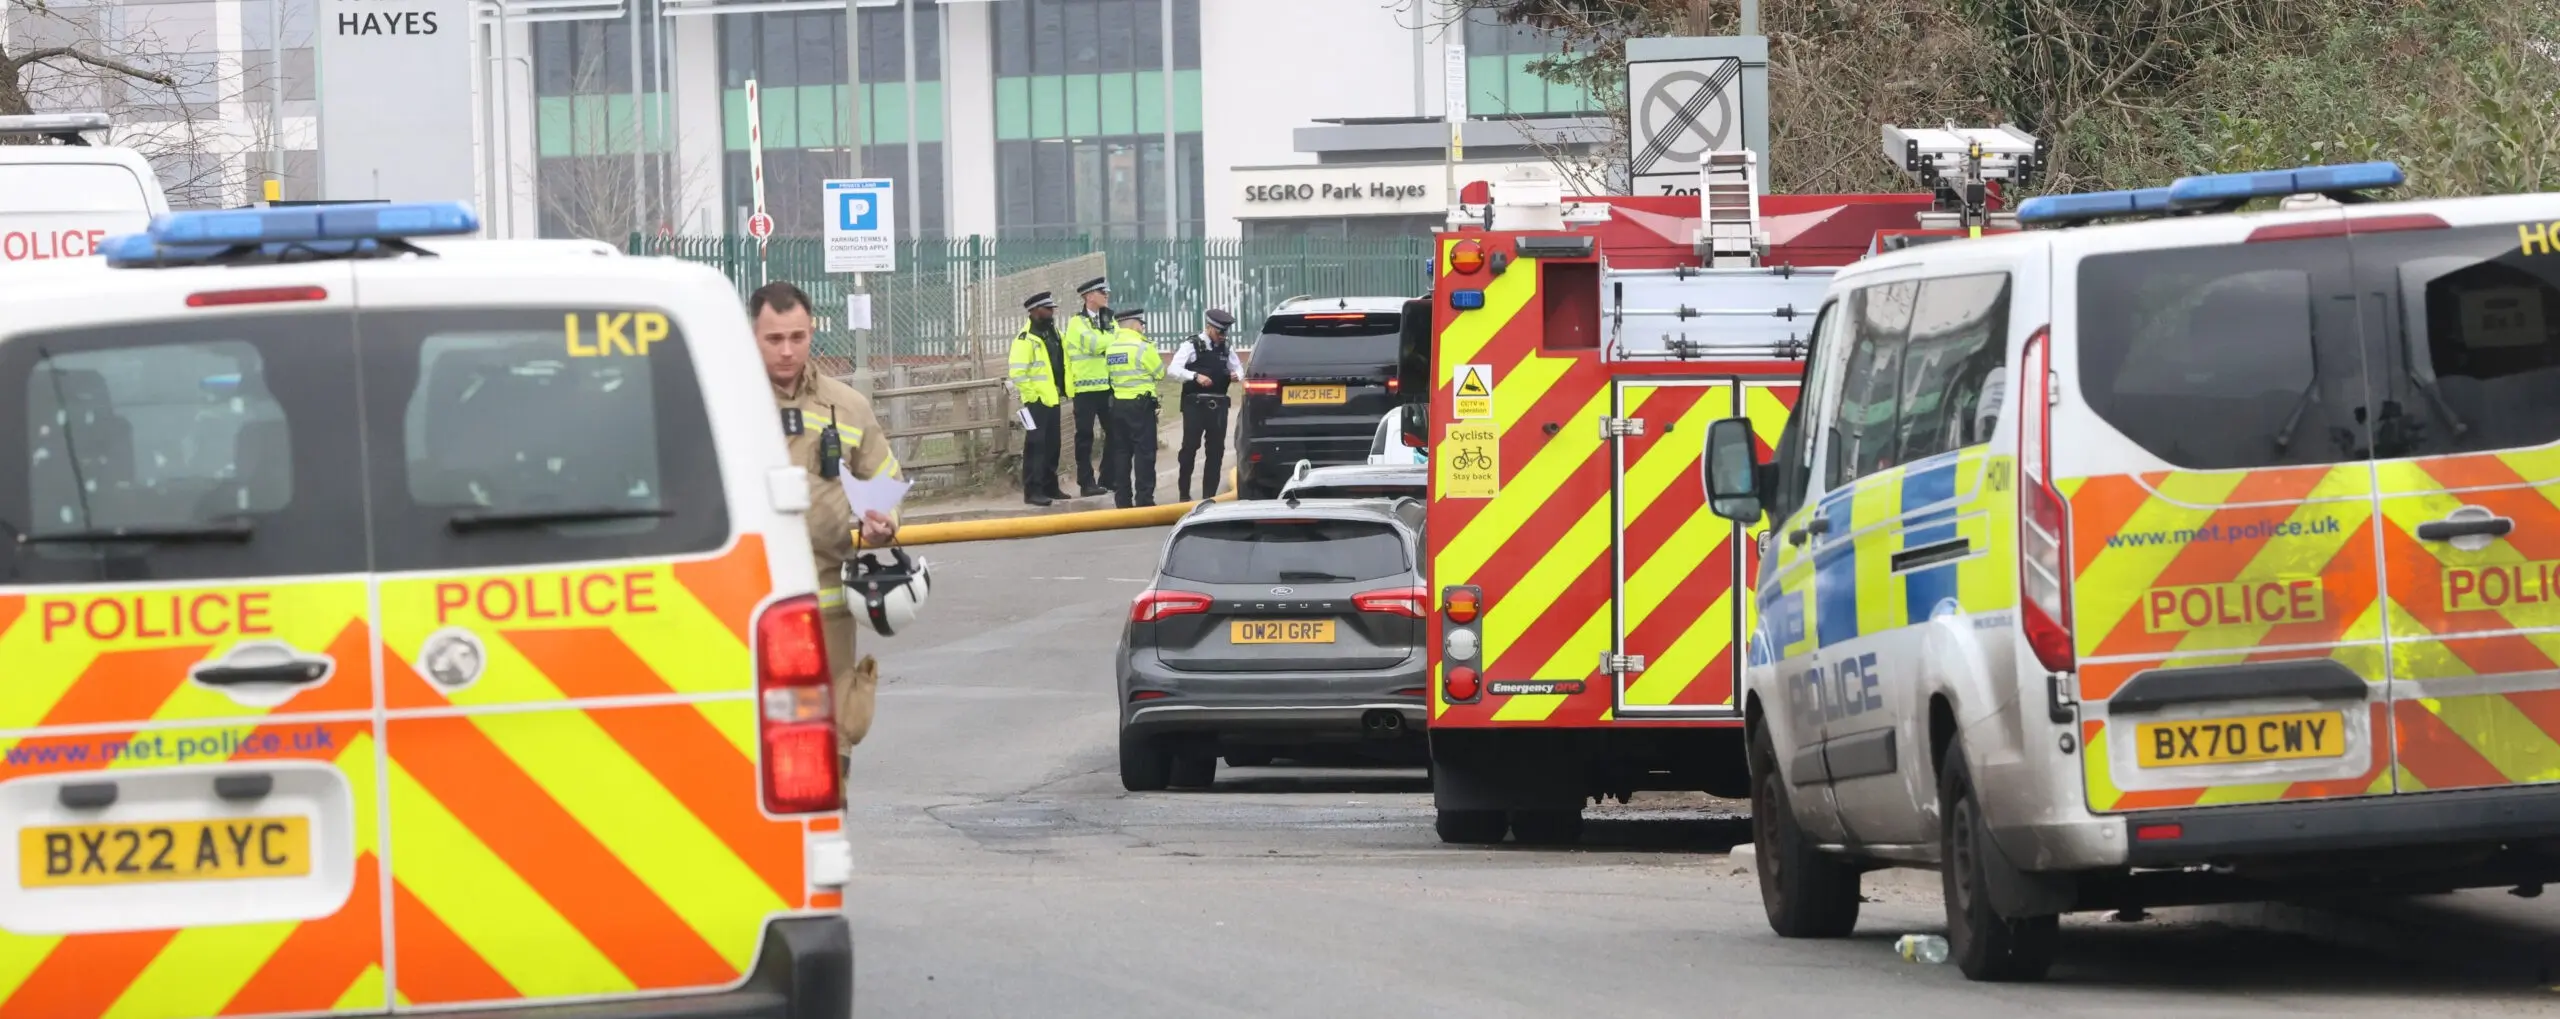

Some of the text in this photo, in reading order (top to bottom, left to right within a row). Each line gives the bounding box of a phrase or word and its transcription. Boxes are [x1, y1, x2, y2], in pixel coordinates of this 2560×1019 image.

[338, 11, 438, 36] HAYES
[1245, 181, 1426, 201] SEGRO Park Hayes
[848, 199, 870, 225] P
[830, 244, 868, 252] CONDITIONS
[564, 311, 669, 357] LKP
[1107, 354, 1127, 364] POLICE
[1318, 388, 1341, 400] HEJ
[1458, 407, 1487, 415] operation
[1451, 430, 1494, 442] Cyclists
[1453, 472, 1492, 481] Stay back
[2106, 516, 2340, 548] www.met.police.uk
[436, 572, 658, 624] POLICE
[2449, 564, 2560, 608] POLI
[2151, 580, 2317, 628] POLICE
[42, 592, 273, 643] POLICE
[1242, 623, 1323, 640] OW21 GRF
[1493, 682, 1580, 694] Emergency one
[1788, 652, 1883, 727] POLICE
[6, 725, 334, 766] www.met.police.uk
[2153, 719, 2327, 760] BX70 CWY
[45, 823, 288, 877] BX22 AYC
